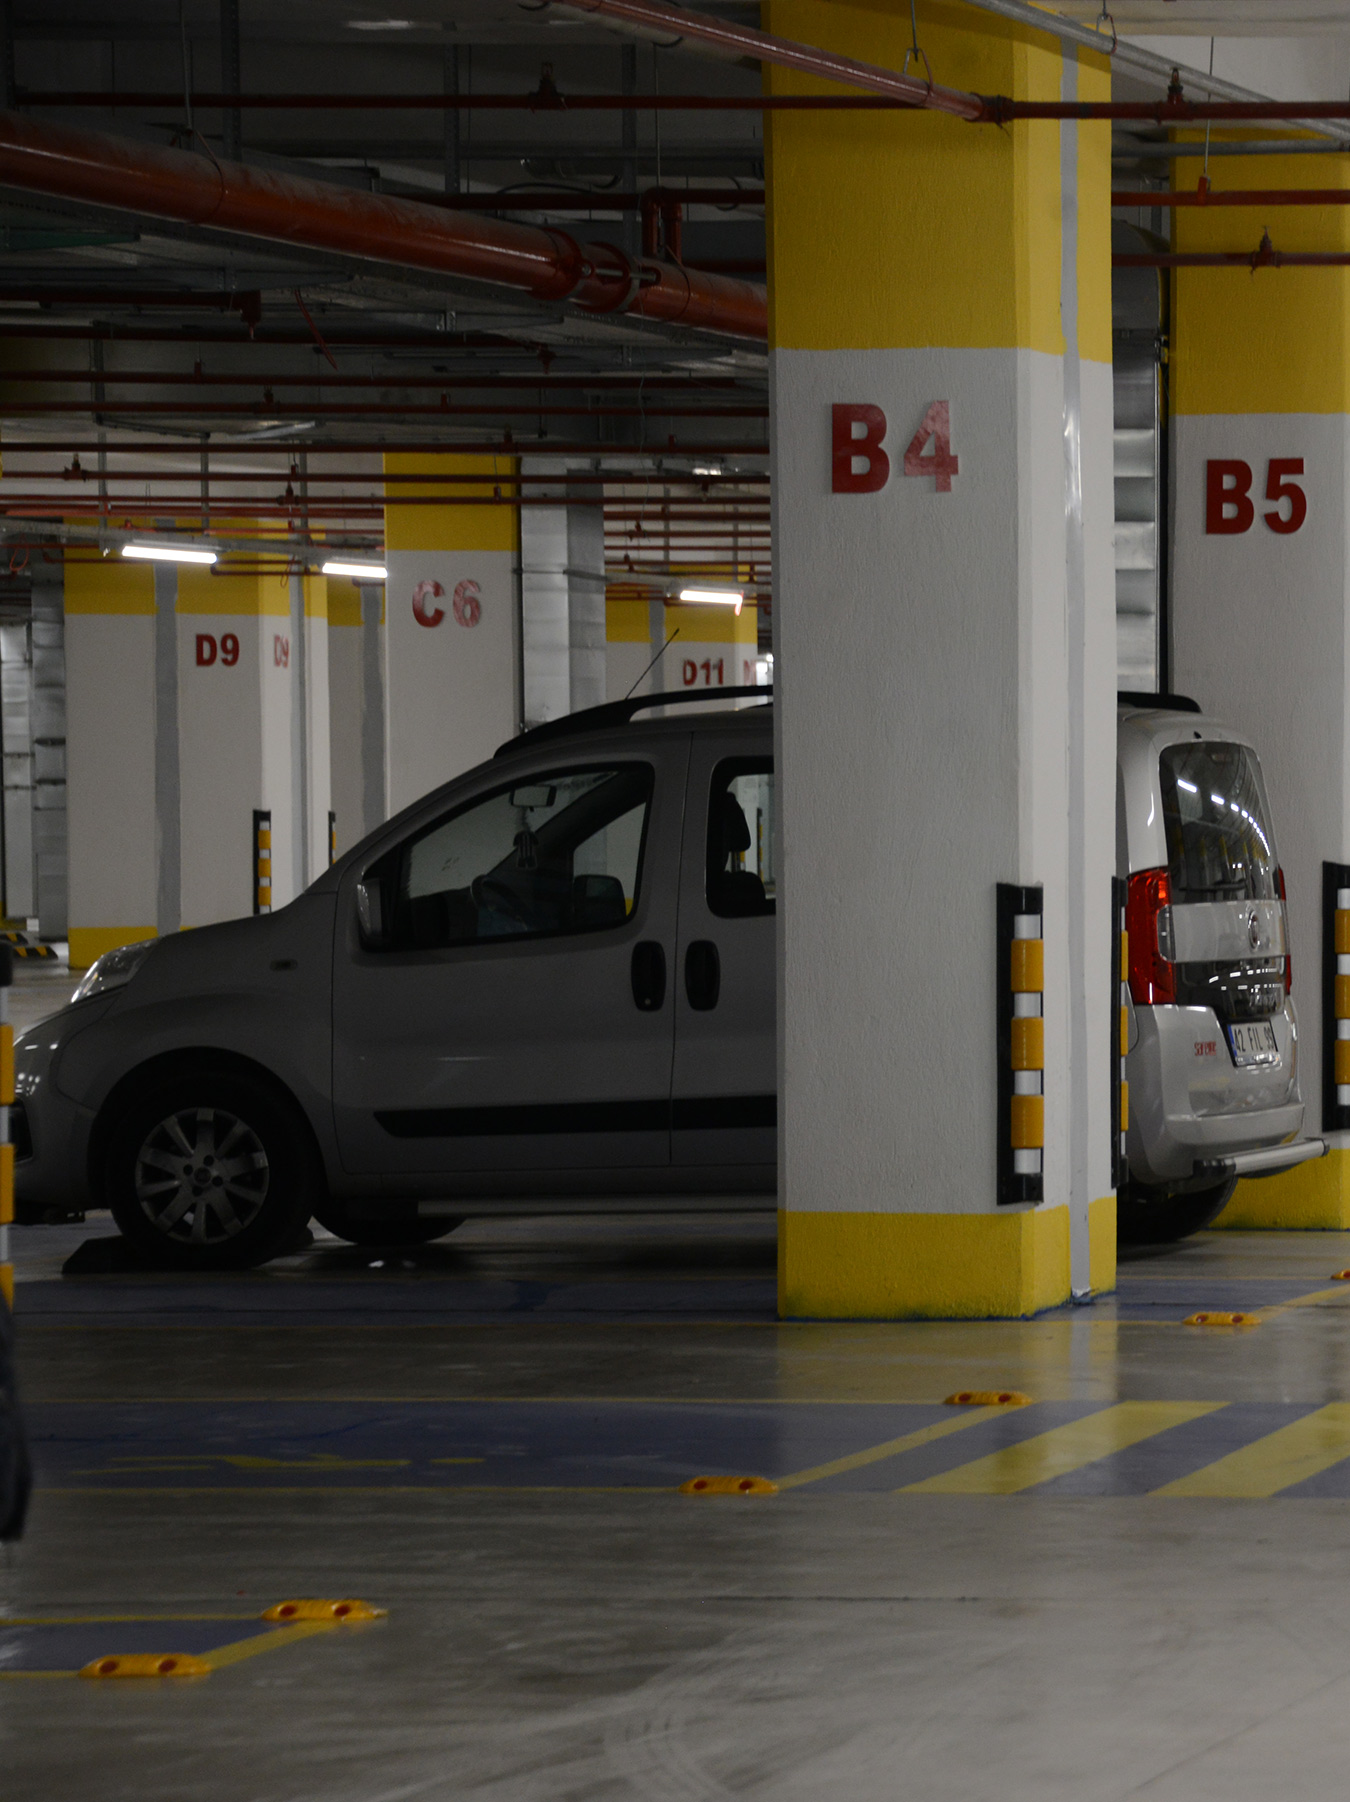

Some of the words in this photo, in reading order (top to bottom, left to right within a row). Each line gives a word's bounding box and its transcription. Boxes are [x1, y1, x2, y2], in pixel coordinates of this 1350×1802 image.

[831, 400, 959, 493] B4
[1205, 457, 1307, 535] B5
[411, 578, 482, 629] C6
[195, 632, 240, 668] D9
[682, 656, 724, 688] D11
